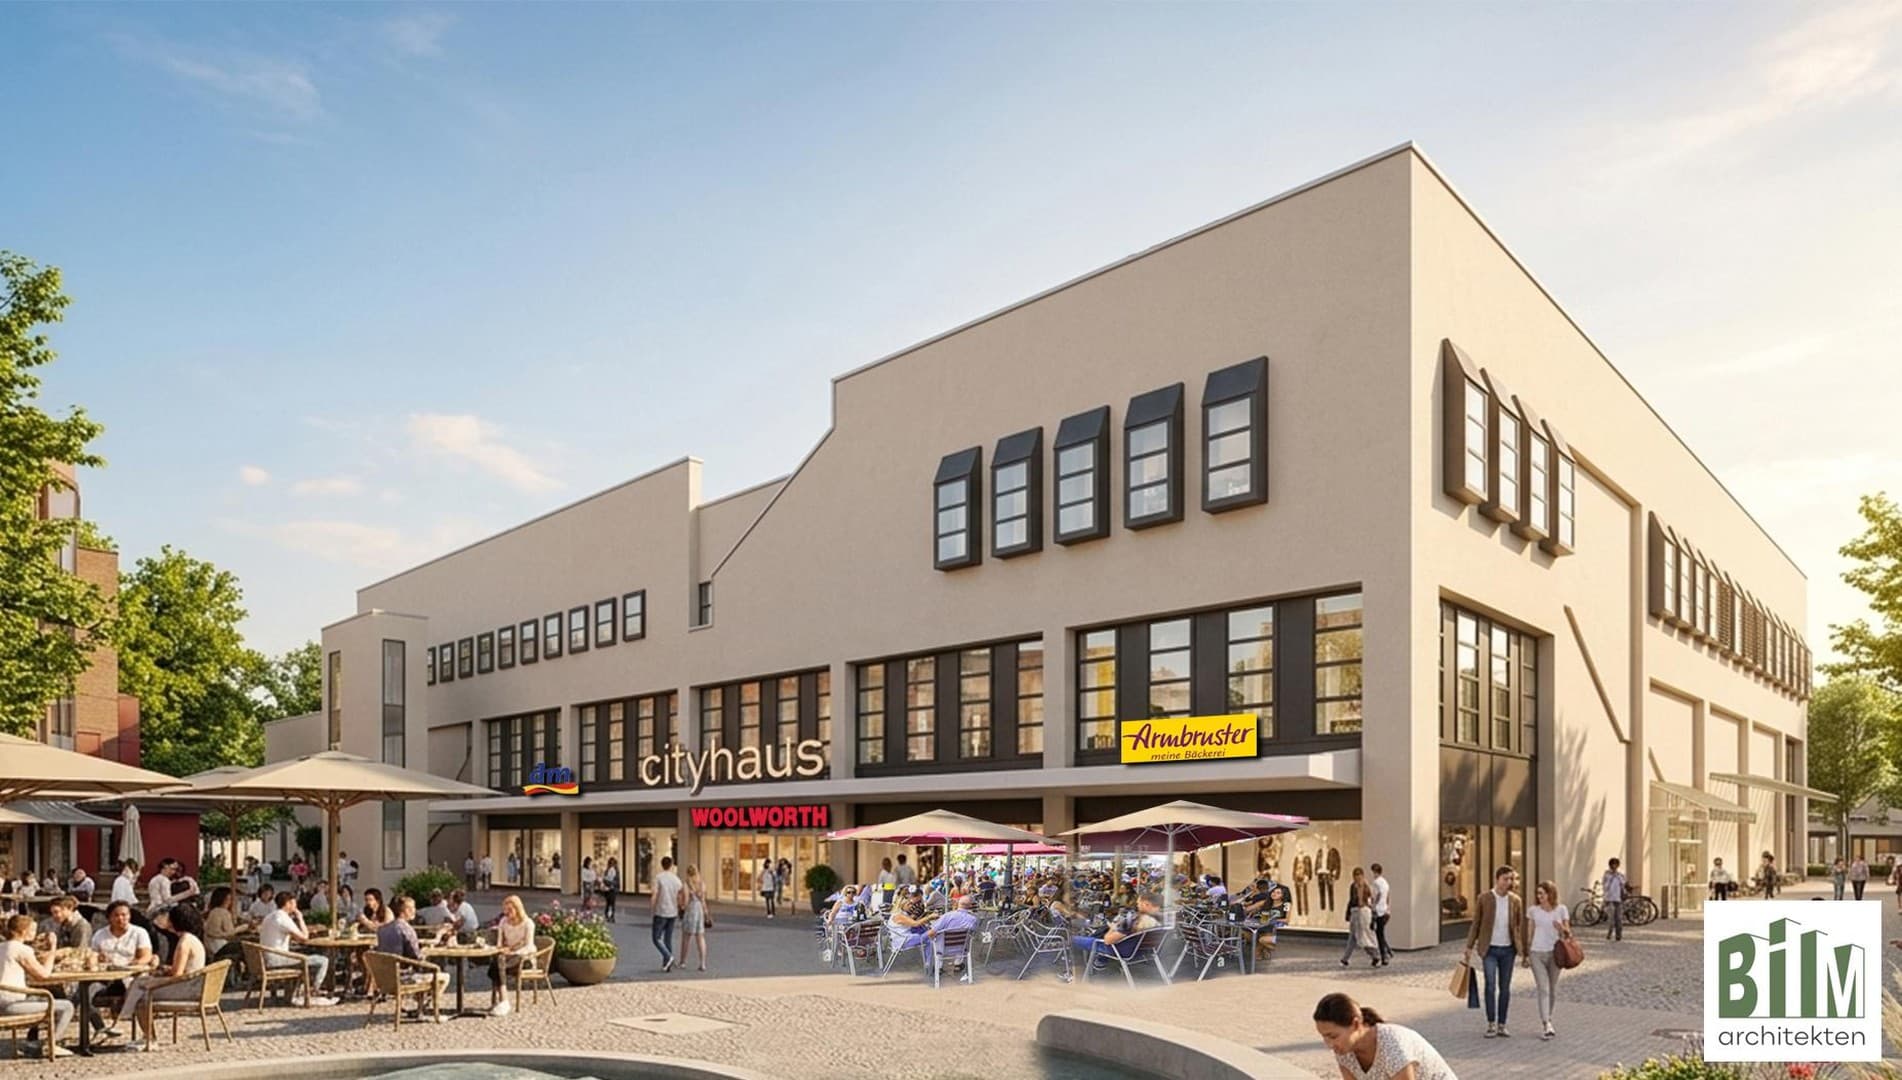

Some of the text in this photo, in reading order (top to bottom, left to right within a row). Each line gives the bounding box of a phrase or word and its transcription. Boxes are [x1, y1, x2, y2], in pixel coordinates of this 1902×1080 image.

[1123, 723, 1255, 750] Armbruster
[641, 736, 825, 795] cityhaus
[1150, 749, 1226, 760] meine Bäckerei
[529, 762, 571, 785] dm
[691, 805, 828, 828] WOOLWORTH
